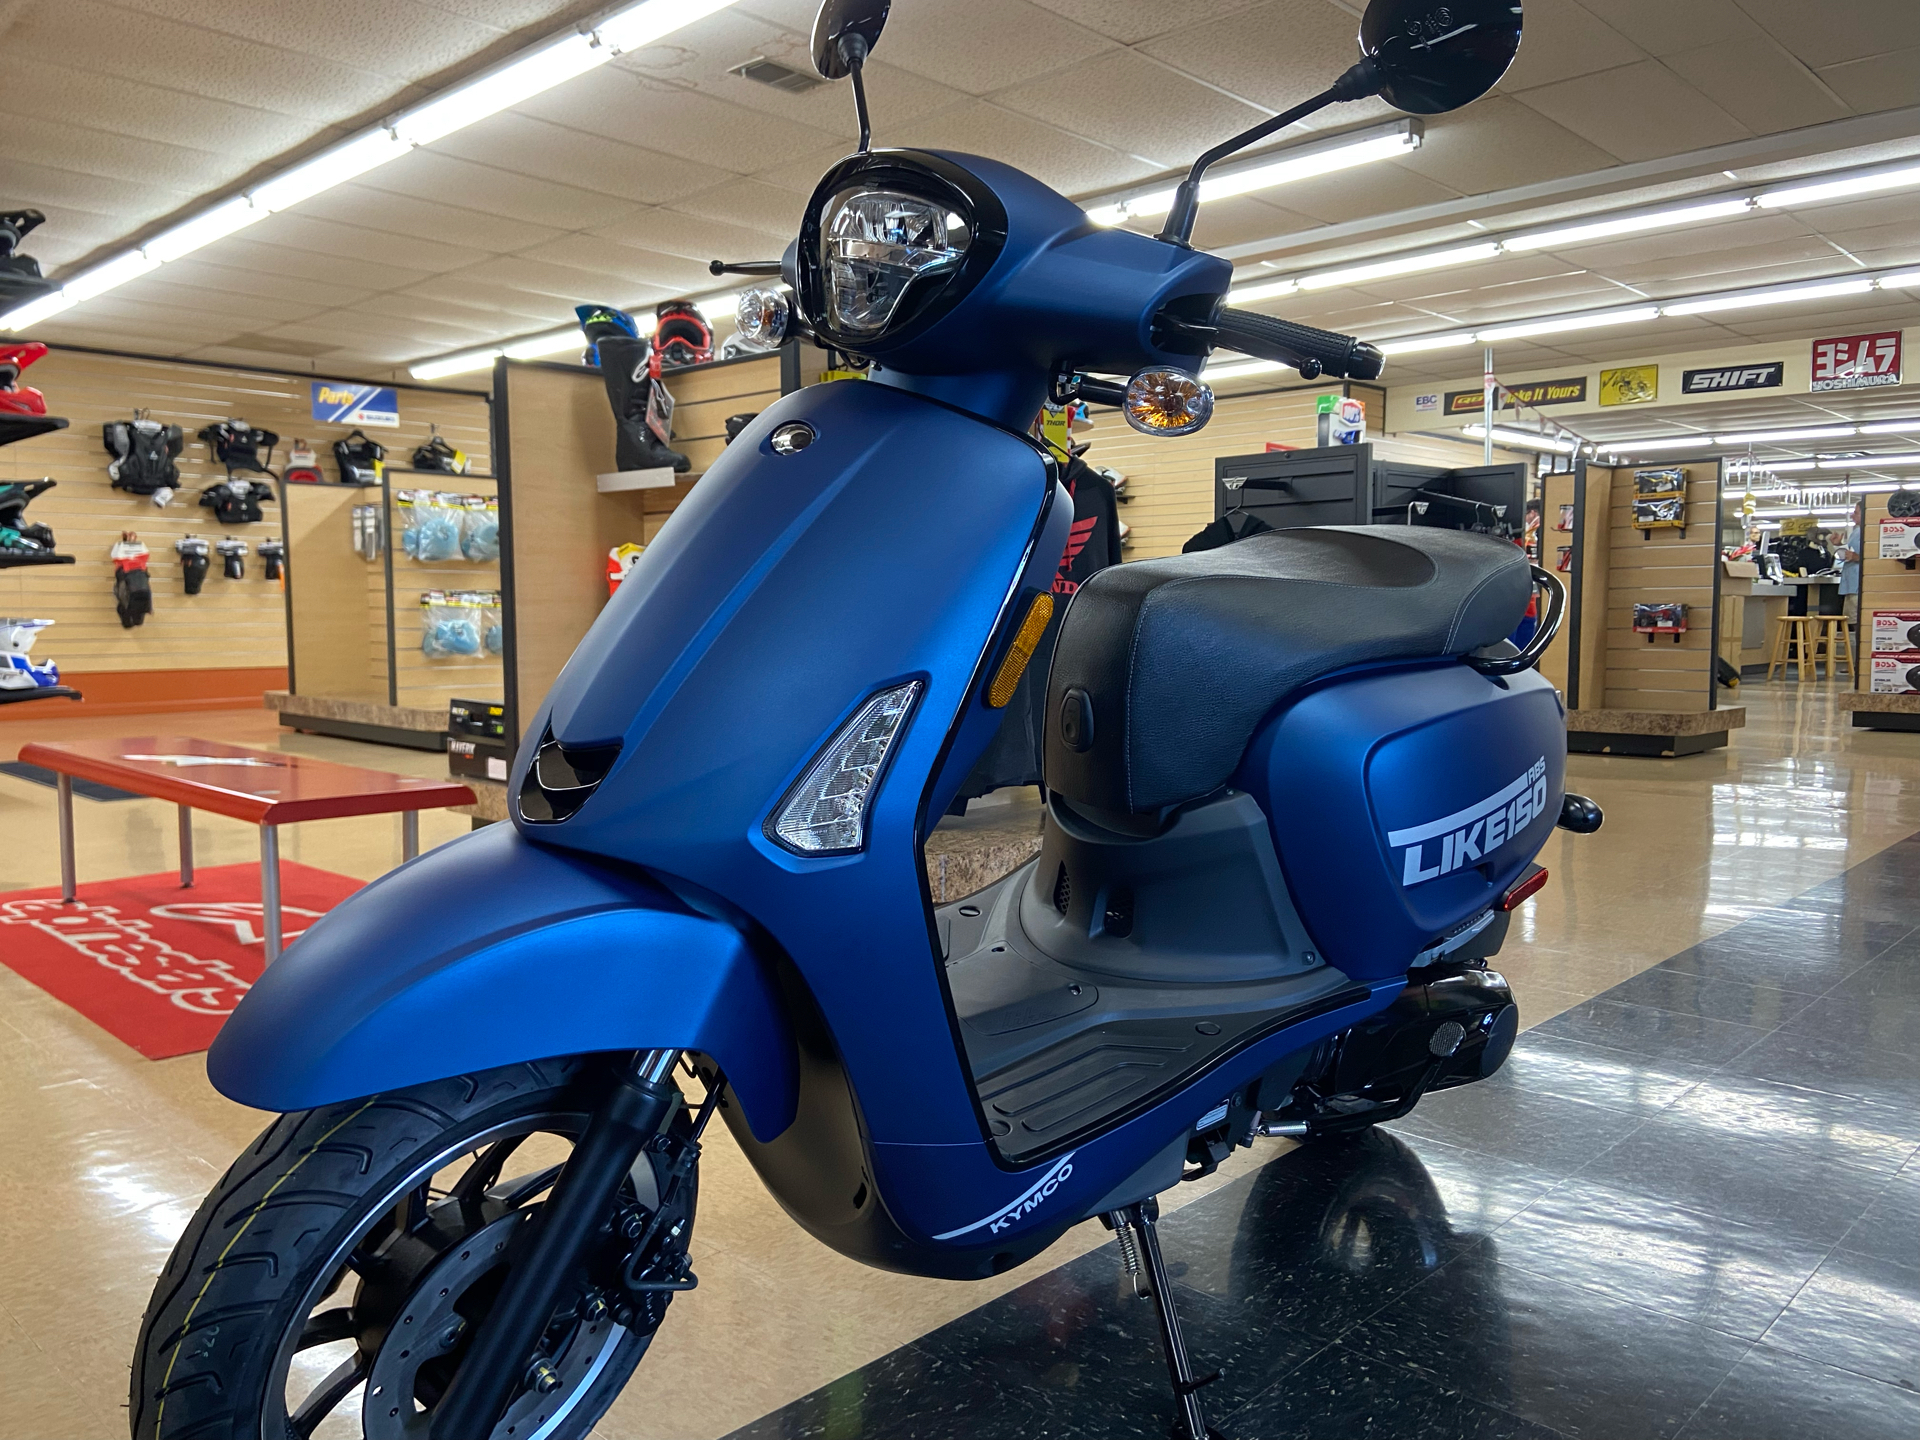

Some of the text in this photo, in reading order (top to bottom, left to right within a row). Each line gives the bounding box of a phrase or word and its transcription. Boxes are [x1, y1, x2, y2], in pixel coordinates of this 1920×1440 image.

[1816, 337, 1896, 377] ヨシムラ
[1690, 366, 1776, 390] SHIFT
[1812, 373, 1899, 391] YOSHIMURA
[318, 386, 355, 406] Parts
[1416, 395, 1437, 405] EBC
[1547, 385, 1581, 399] Yours
[1528, 755, 1546, 785] ABS
[989, 1163, 1073, 1234] KYMCO
